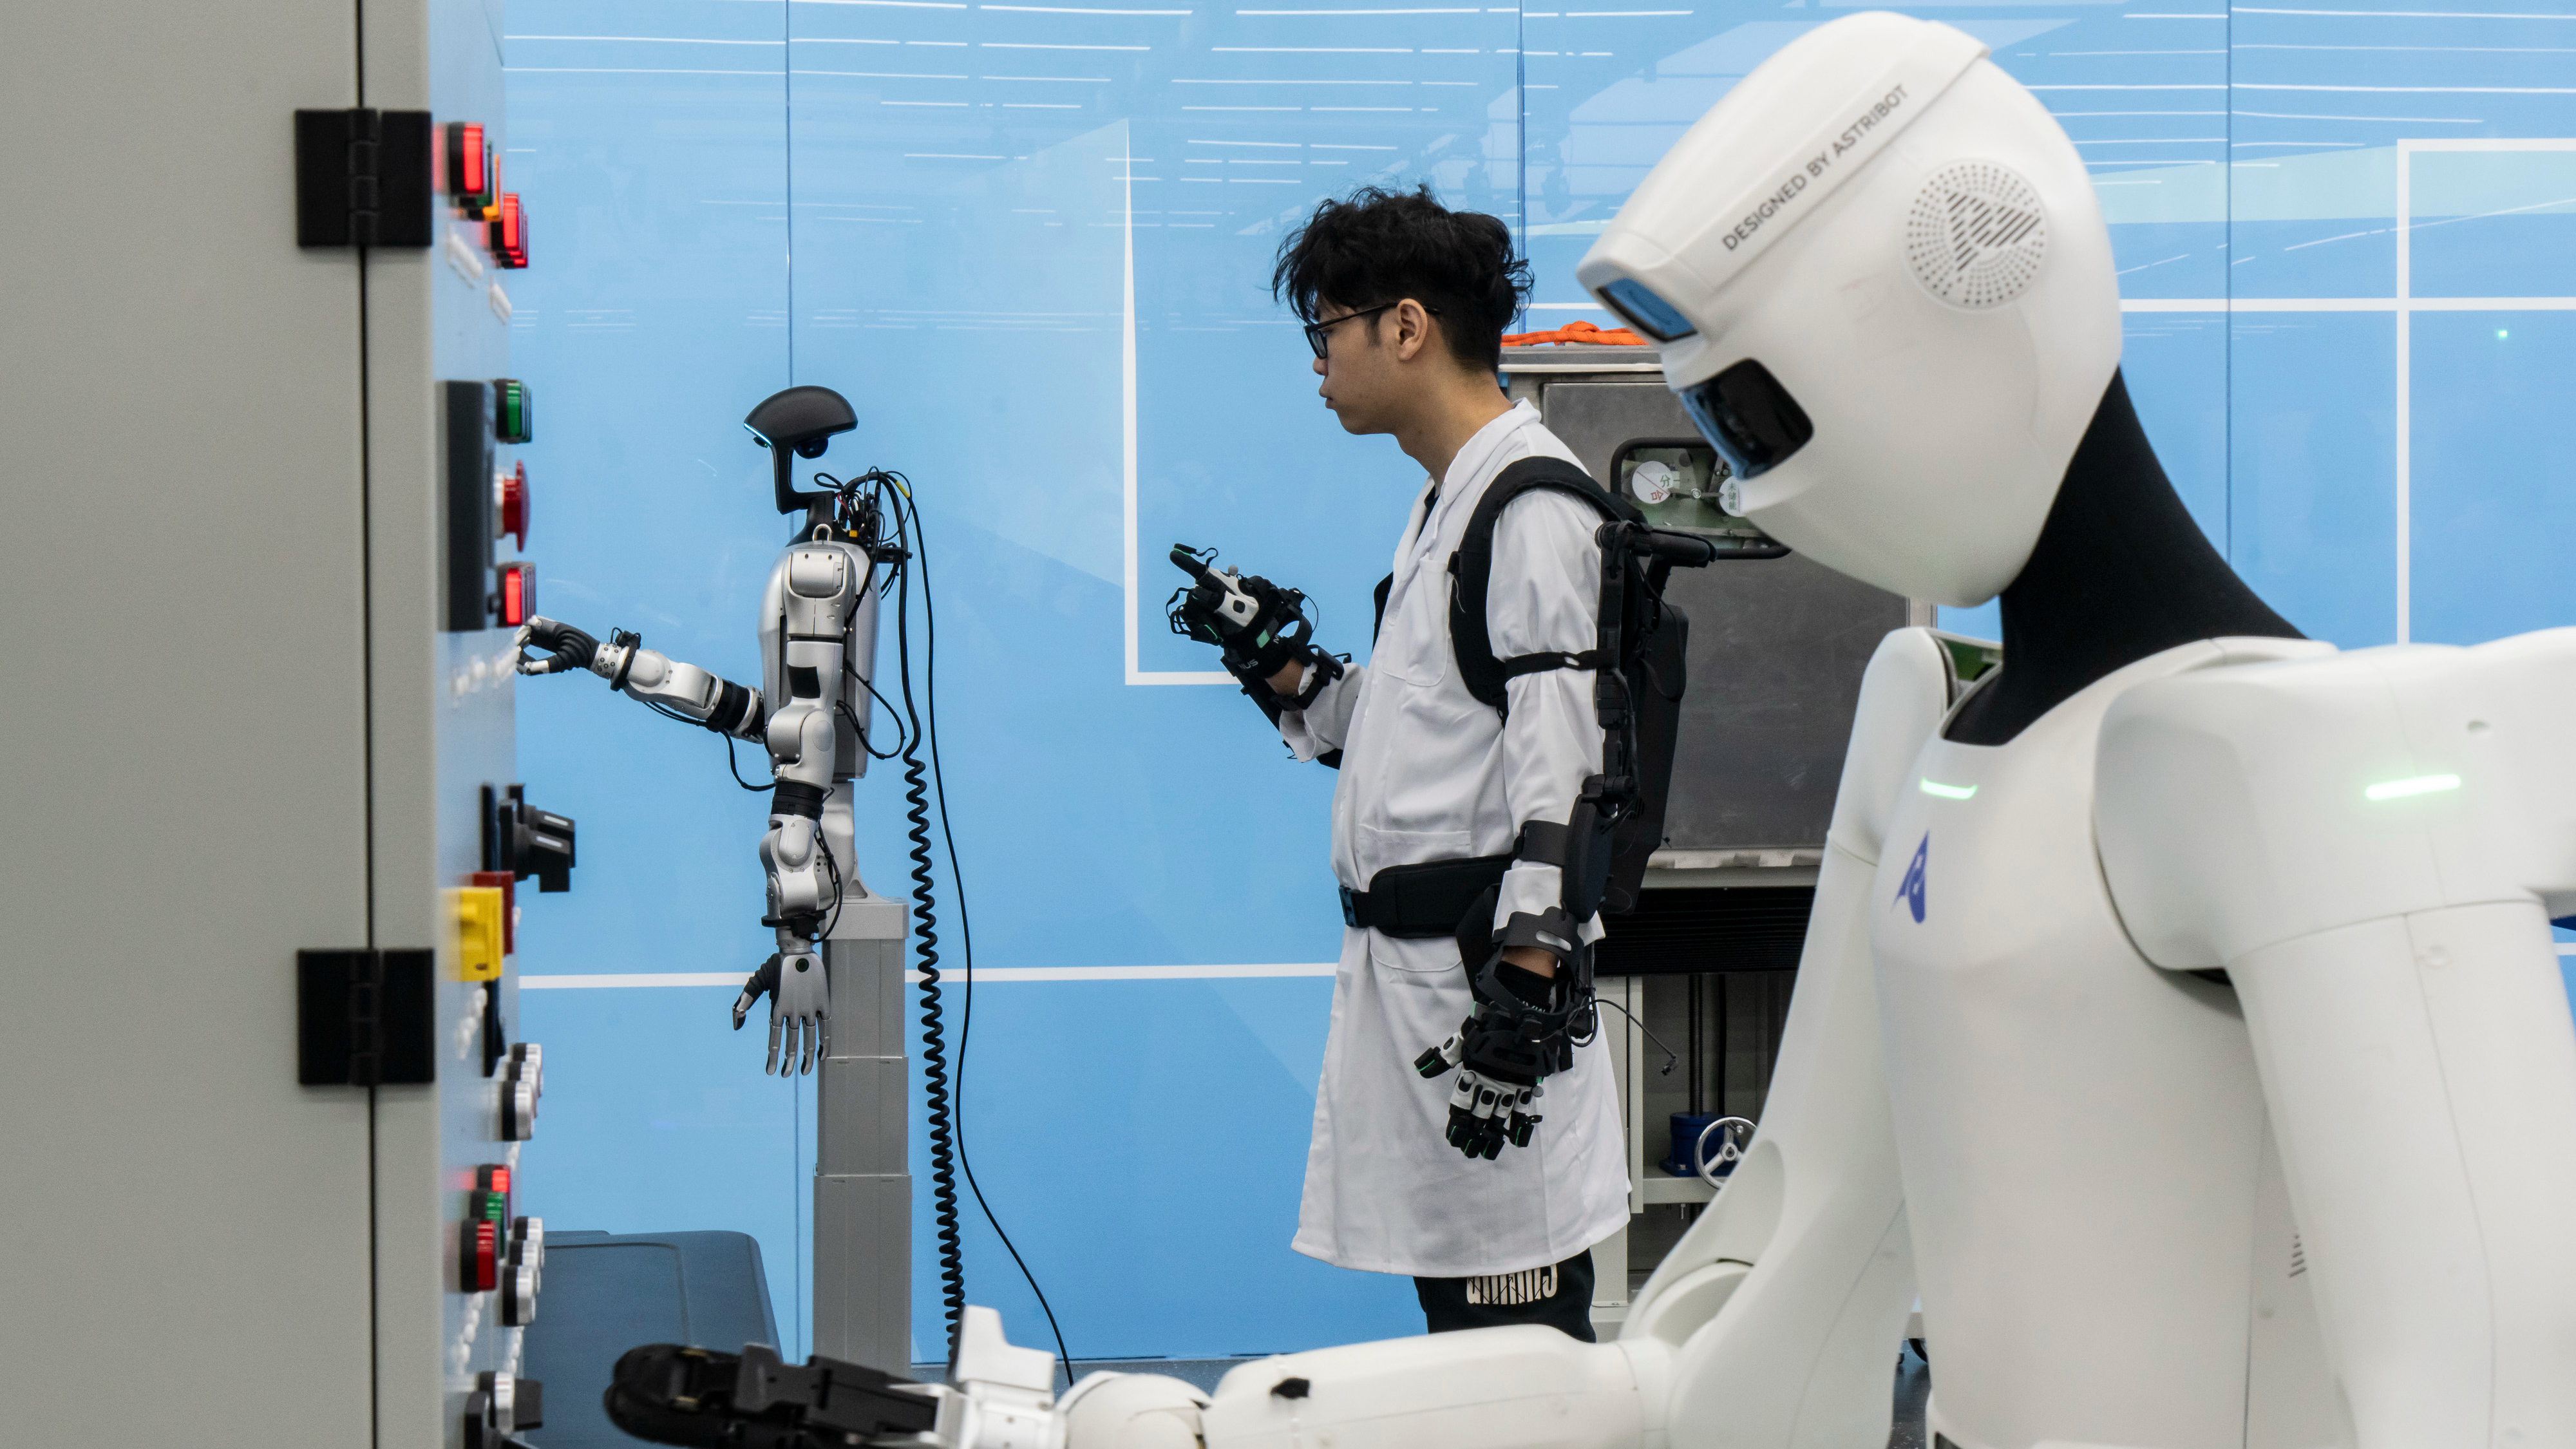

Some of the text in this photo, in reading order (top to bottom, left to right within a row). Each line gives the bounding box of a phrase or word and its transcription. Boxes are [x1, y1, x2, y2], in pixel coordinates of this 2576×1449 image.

[1722, 84, 1908, 251] DESIGNED BY ASTRIBOT
[1660, 474, 1671, 488] 分
[1651, 489, 1664, 501] 合
